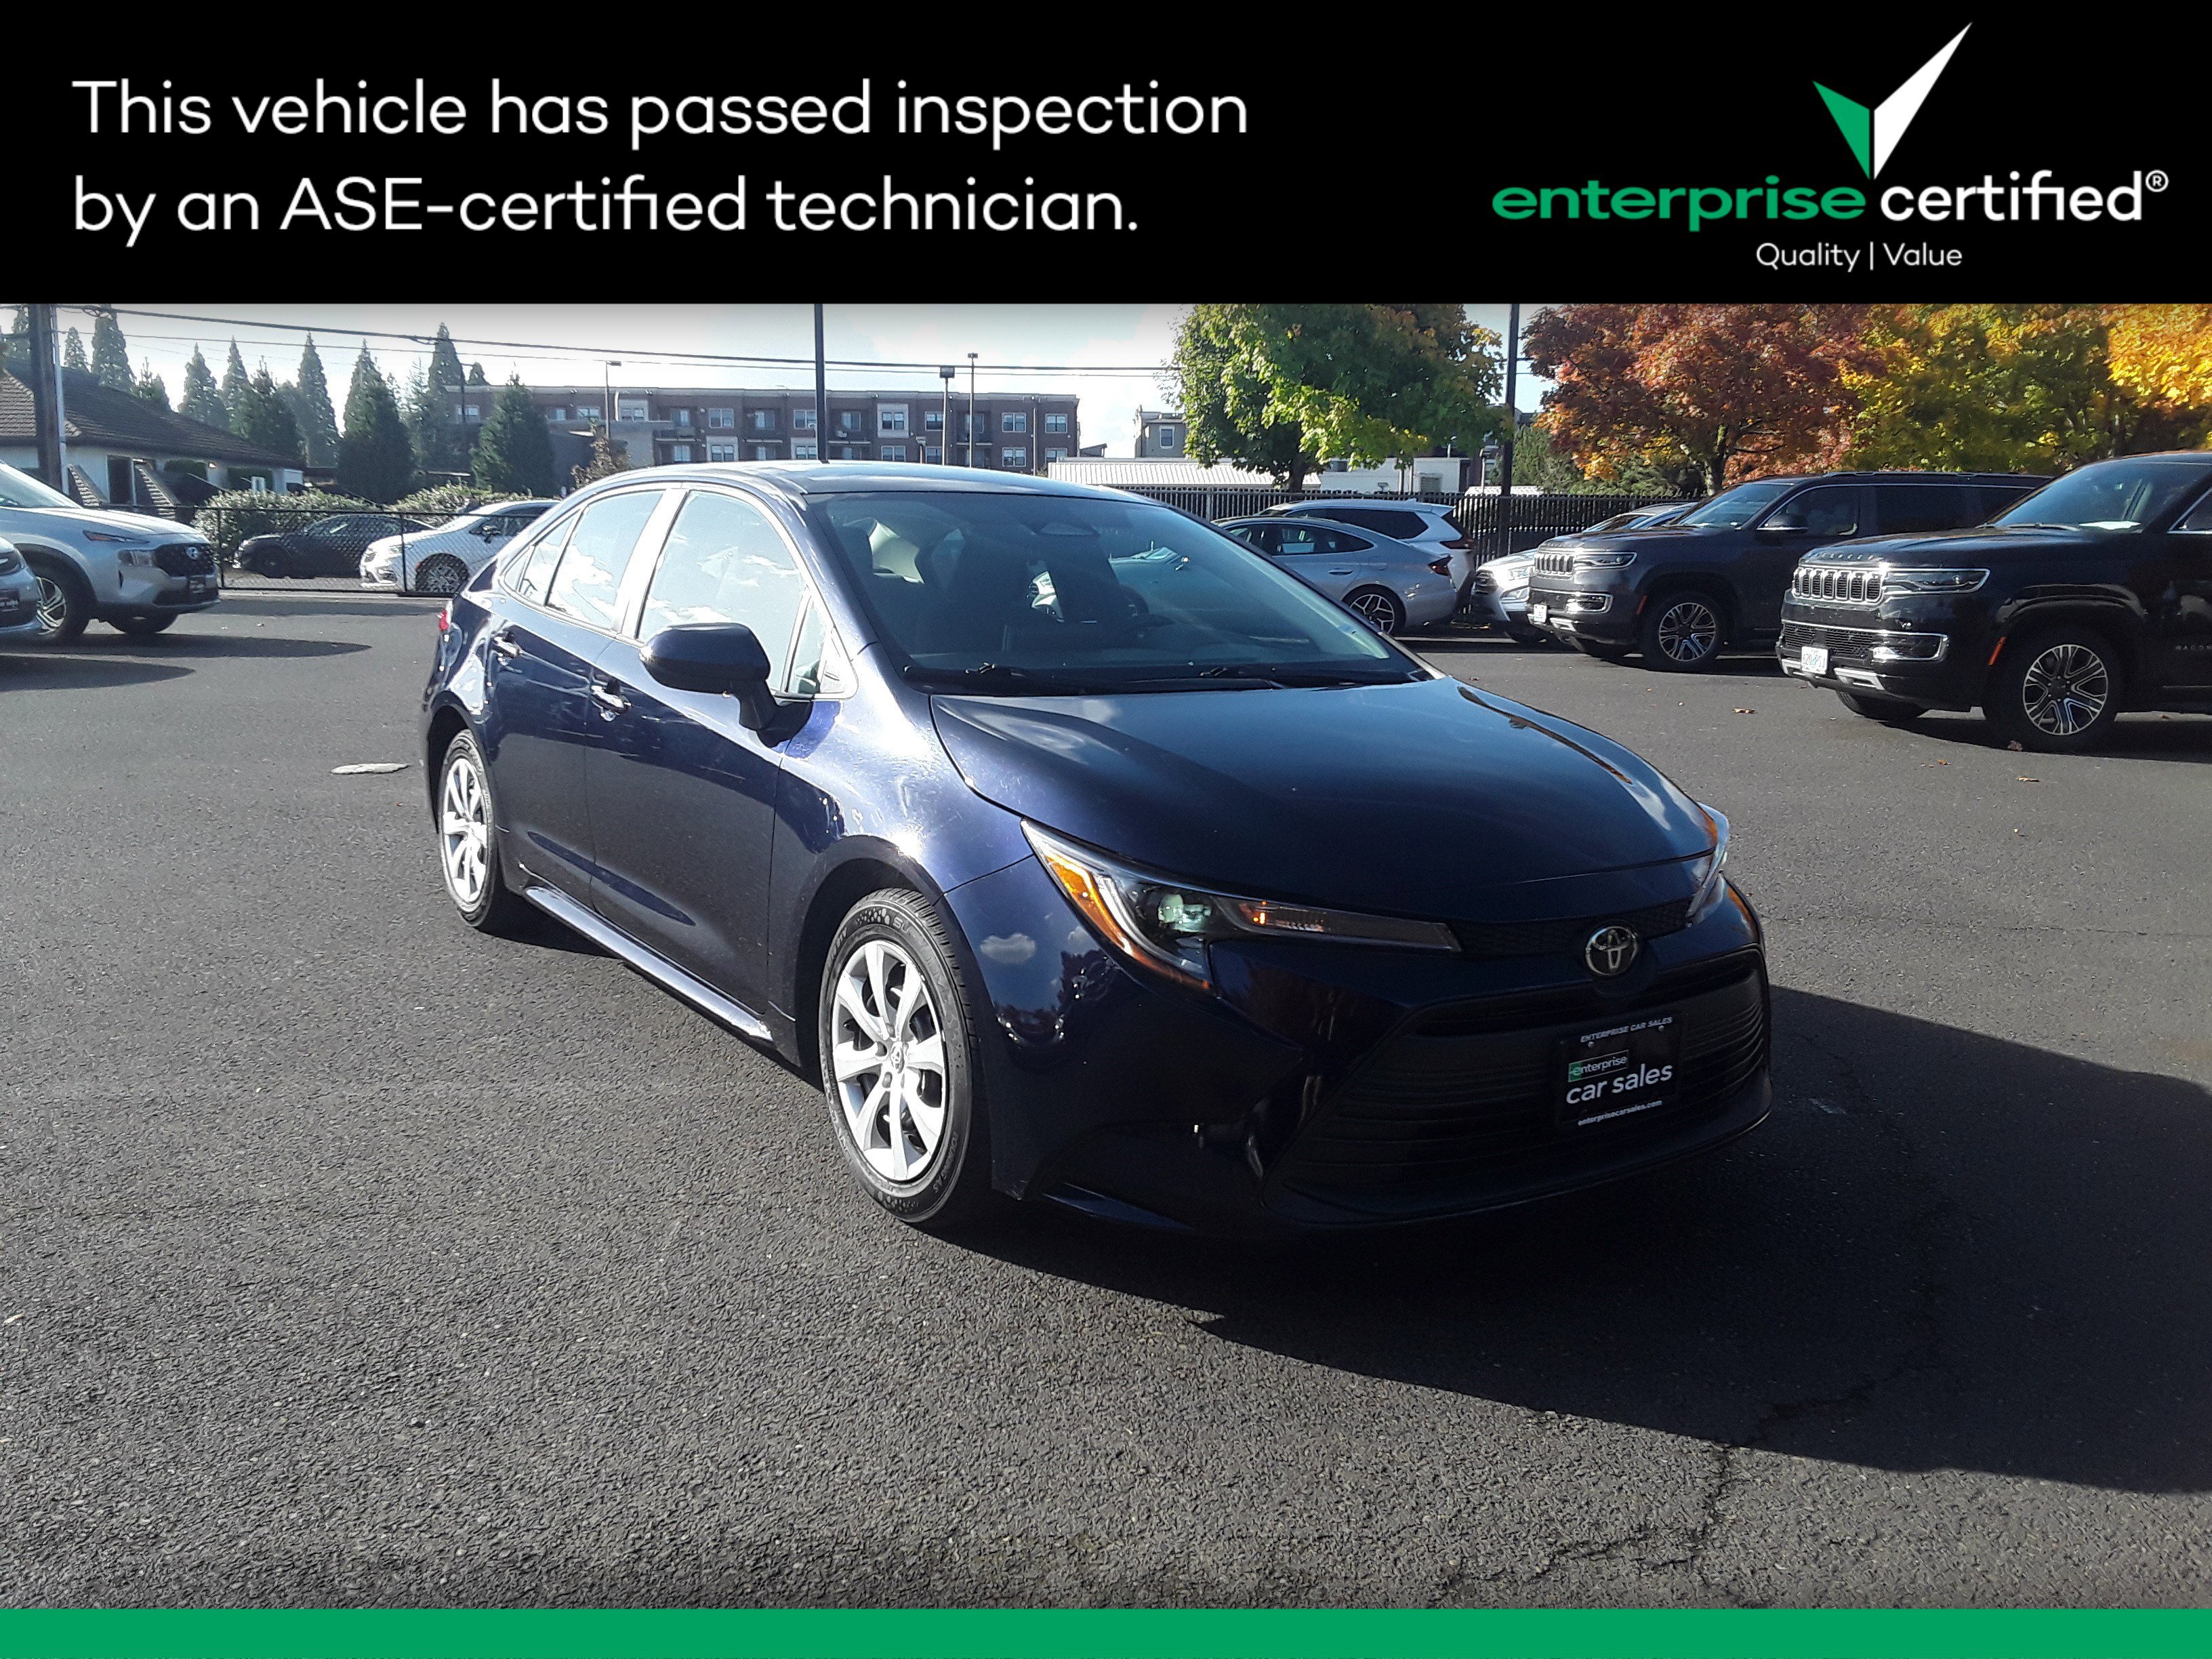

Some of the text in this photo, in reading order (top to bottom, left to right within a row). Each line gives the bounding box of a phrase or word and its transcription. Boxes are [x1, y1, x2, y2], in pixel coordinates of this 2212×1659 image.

[1630, 1022, 1647, 1031] CAR
[1647, 1017, 1673, 1027] SALES
[1570, 1056, 1628, 1076] enterprise
[1566, 1063, 1673, 1104] car sales
